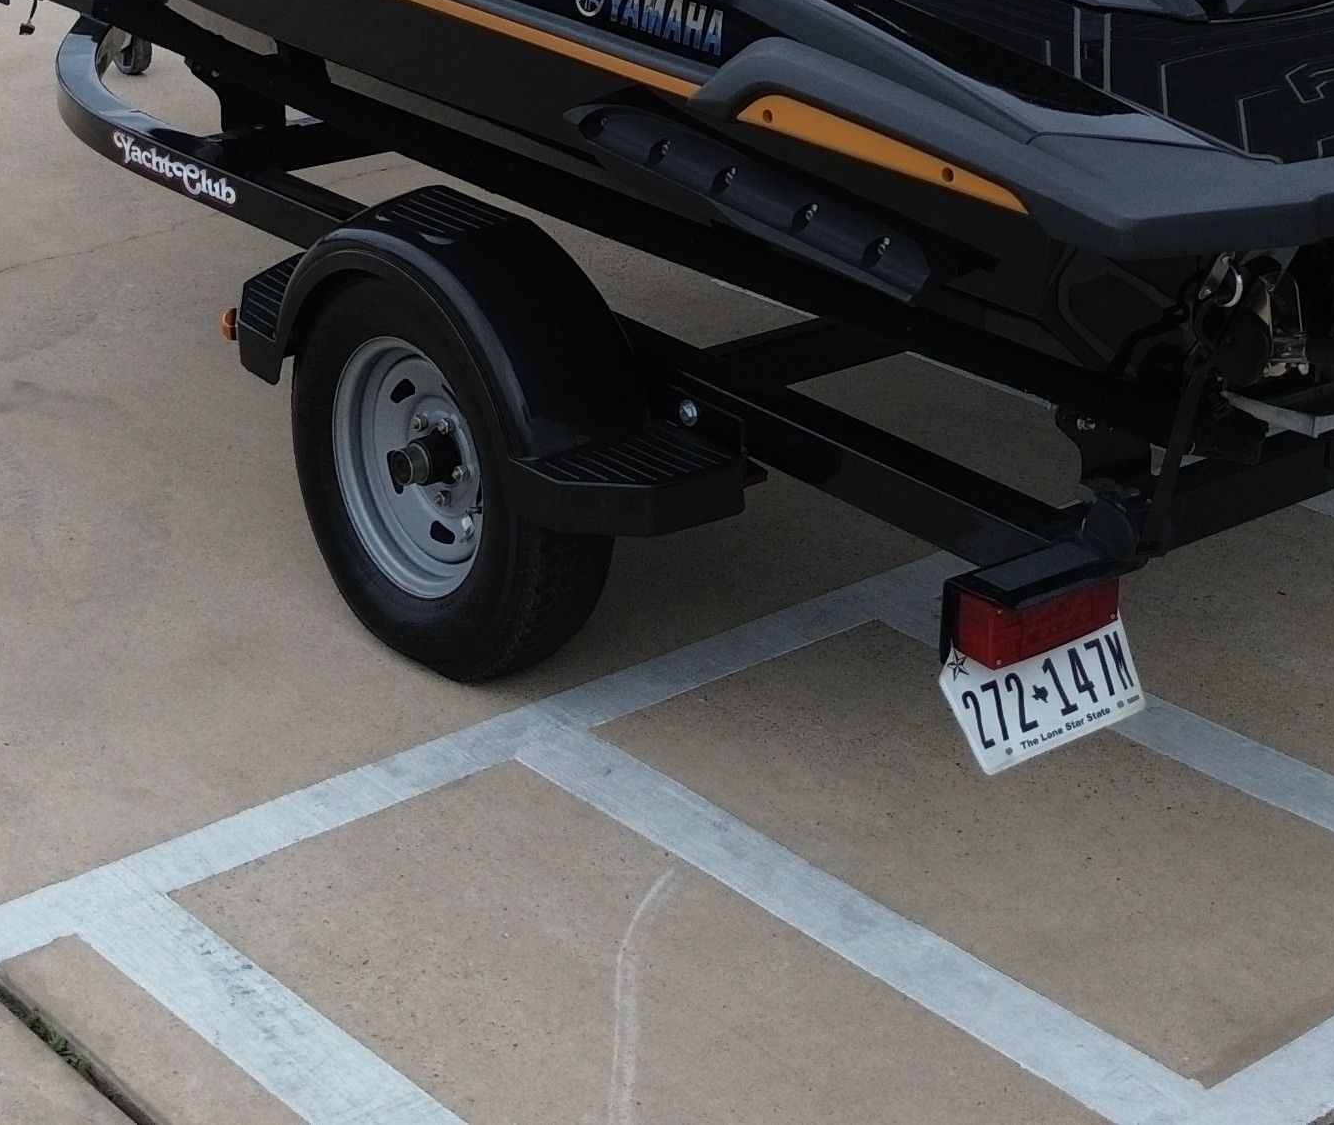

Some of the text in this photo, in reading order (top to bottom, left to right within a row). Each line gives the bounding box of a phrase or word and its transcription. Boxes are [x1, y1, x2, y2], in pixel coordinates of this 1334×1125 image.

[1020, 707, 1111, 750] The Lone Star State
